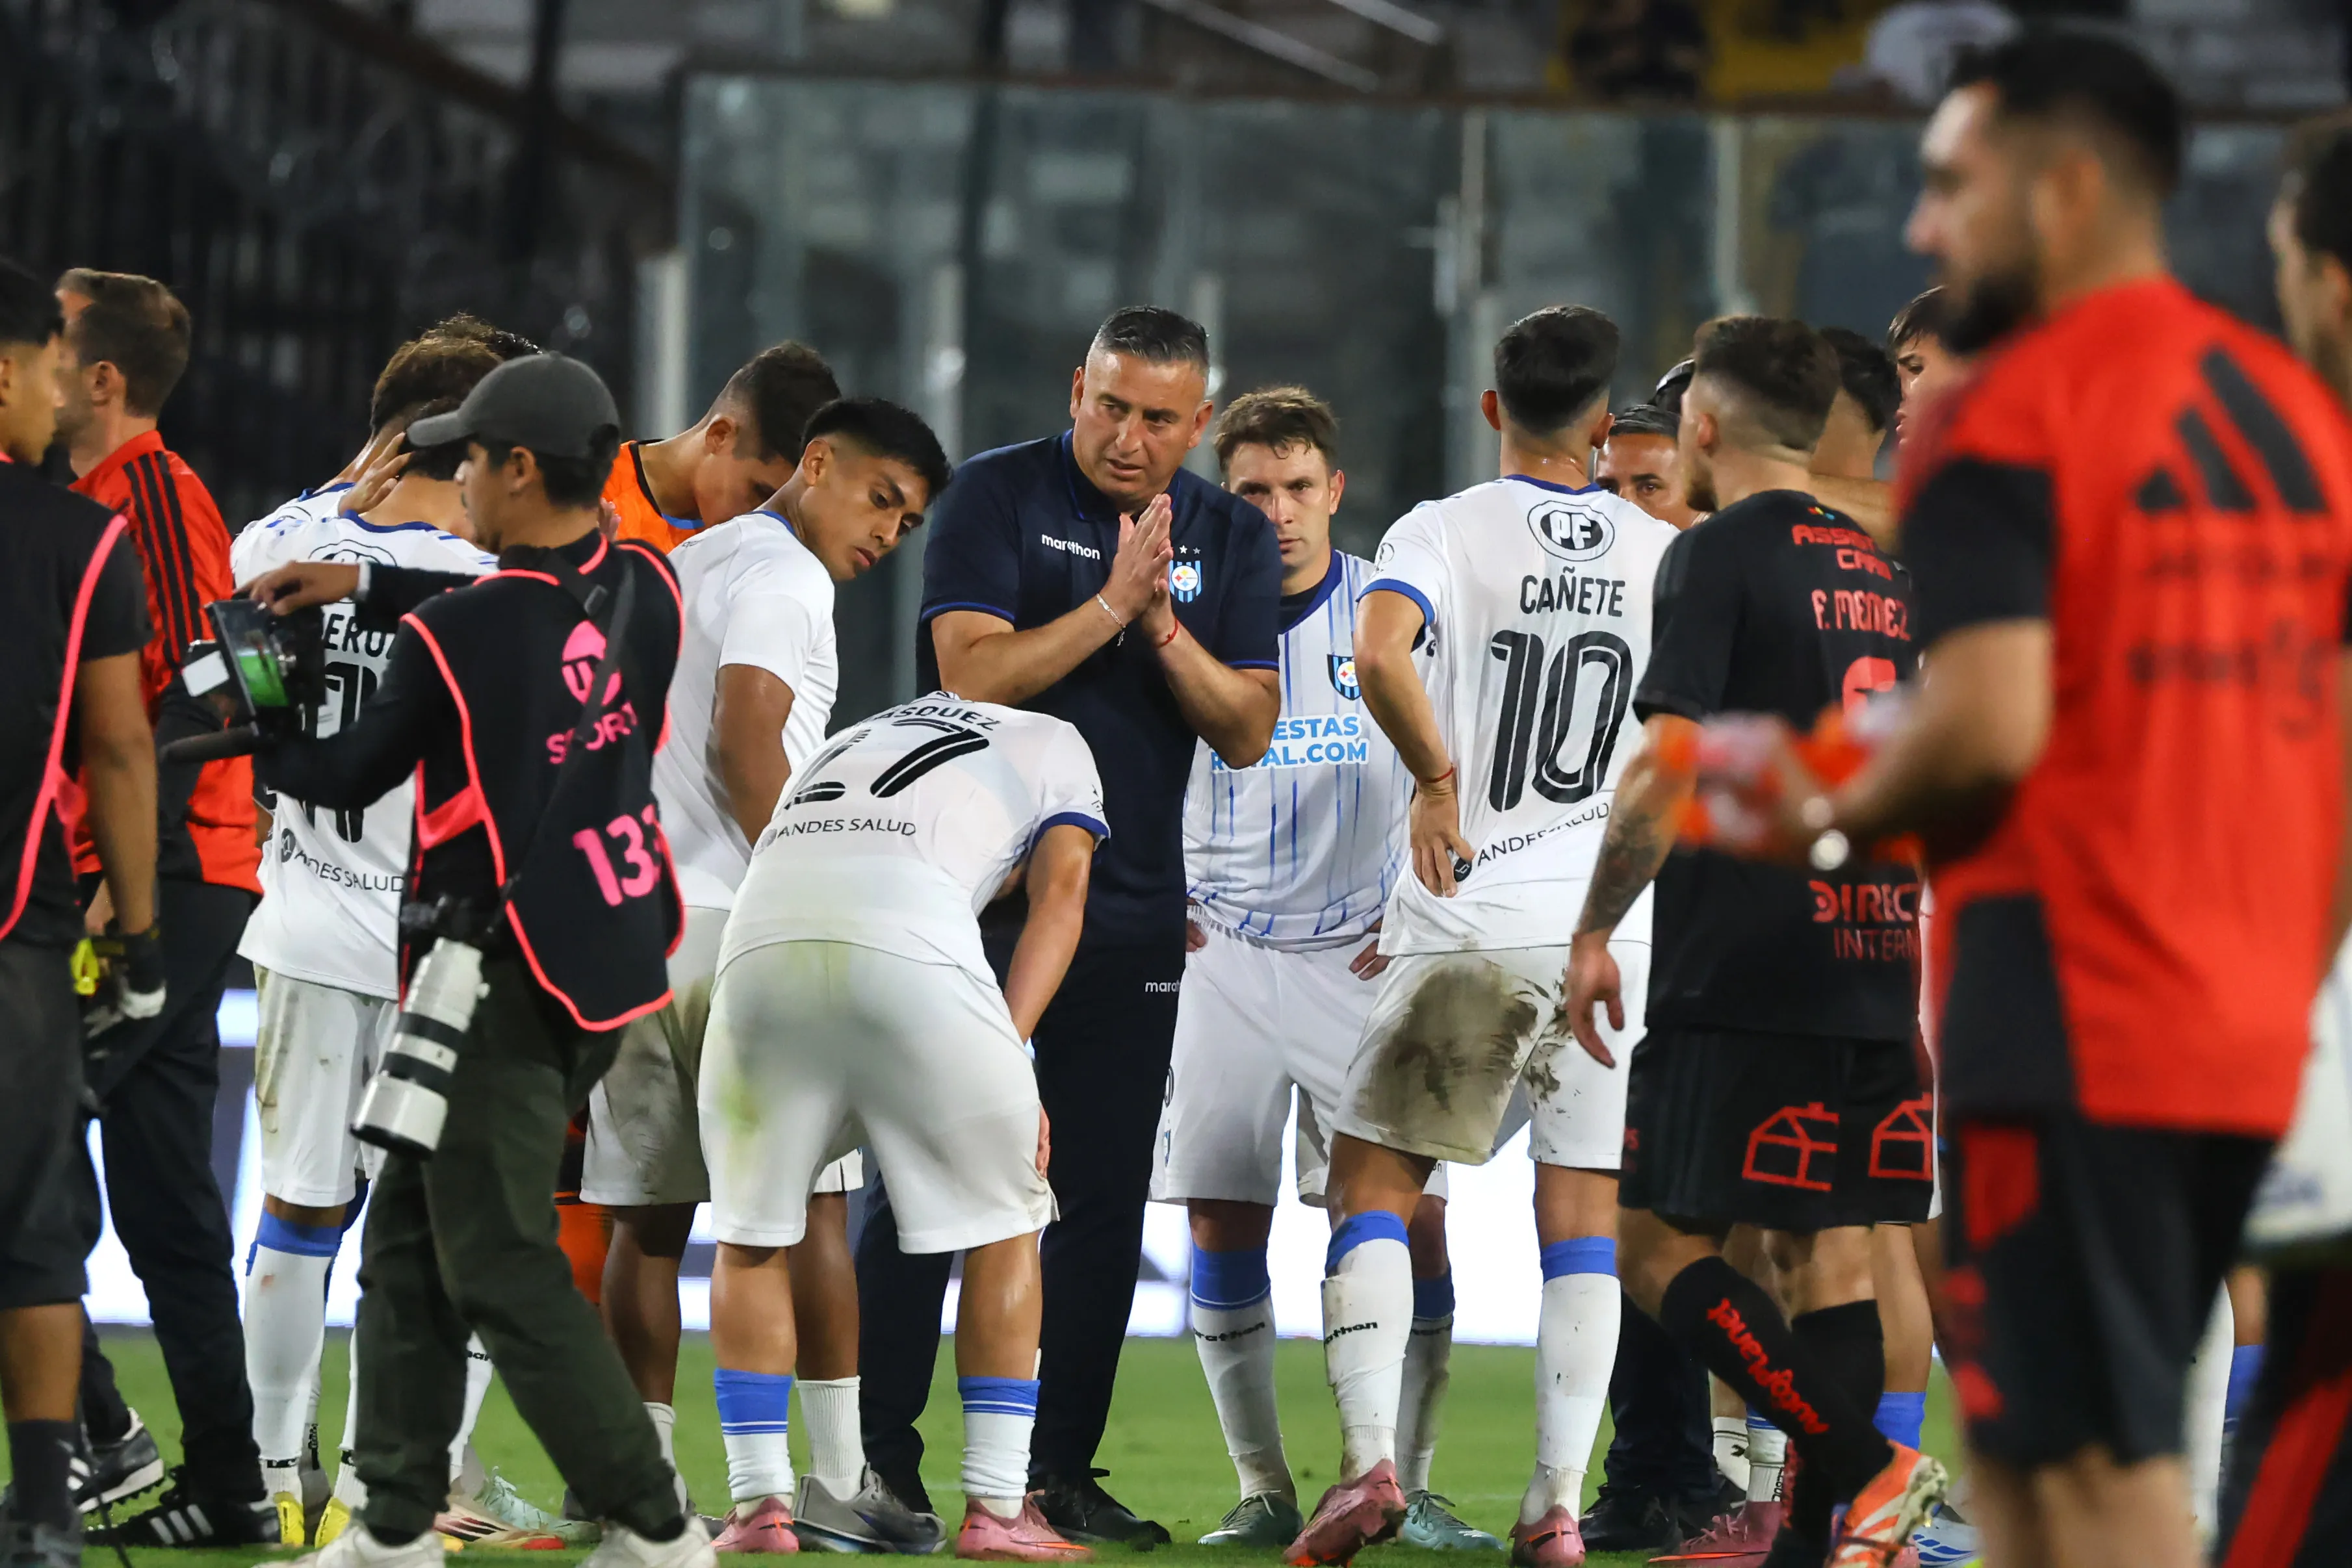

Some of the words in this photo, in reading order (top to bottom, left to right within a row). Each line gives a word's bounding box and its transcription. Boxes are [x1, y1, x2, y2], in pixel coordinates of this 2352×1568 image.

[1549, 510, 1592, 550] PF
[1519, 565, 1626, 617] CAÑETE
[871, 706, 1002, 731] ASQUEZ
[1273, 716, 1360, 741] ESTAS
[1489, 629, 1633, 813] 10
[1211, 742, 1367, 771] RAL.COM
[777, 819, 845, 838] ANDES
[848, 818, 916, 836] SALUD
